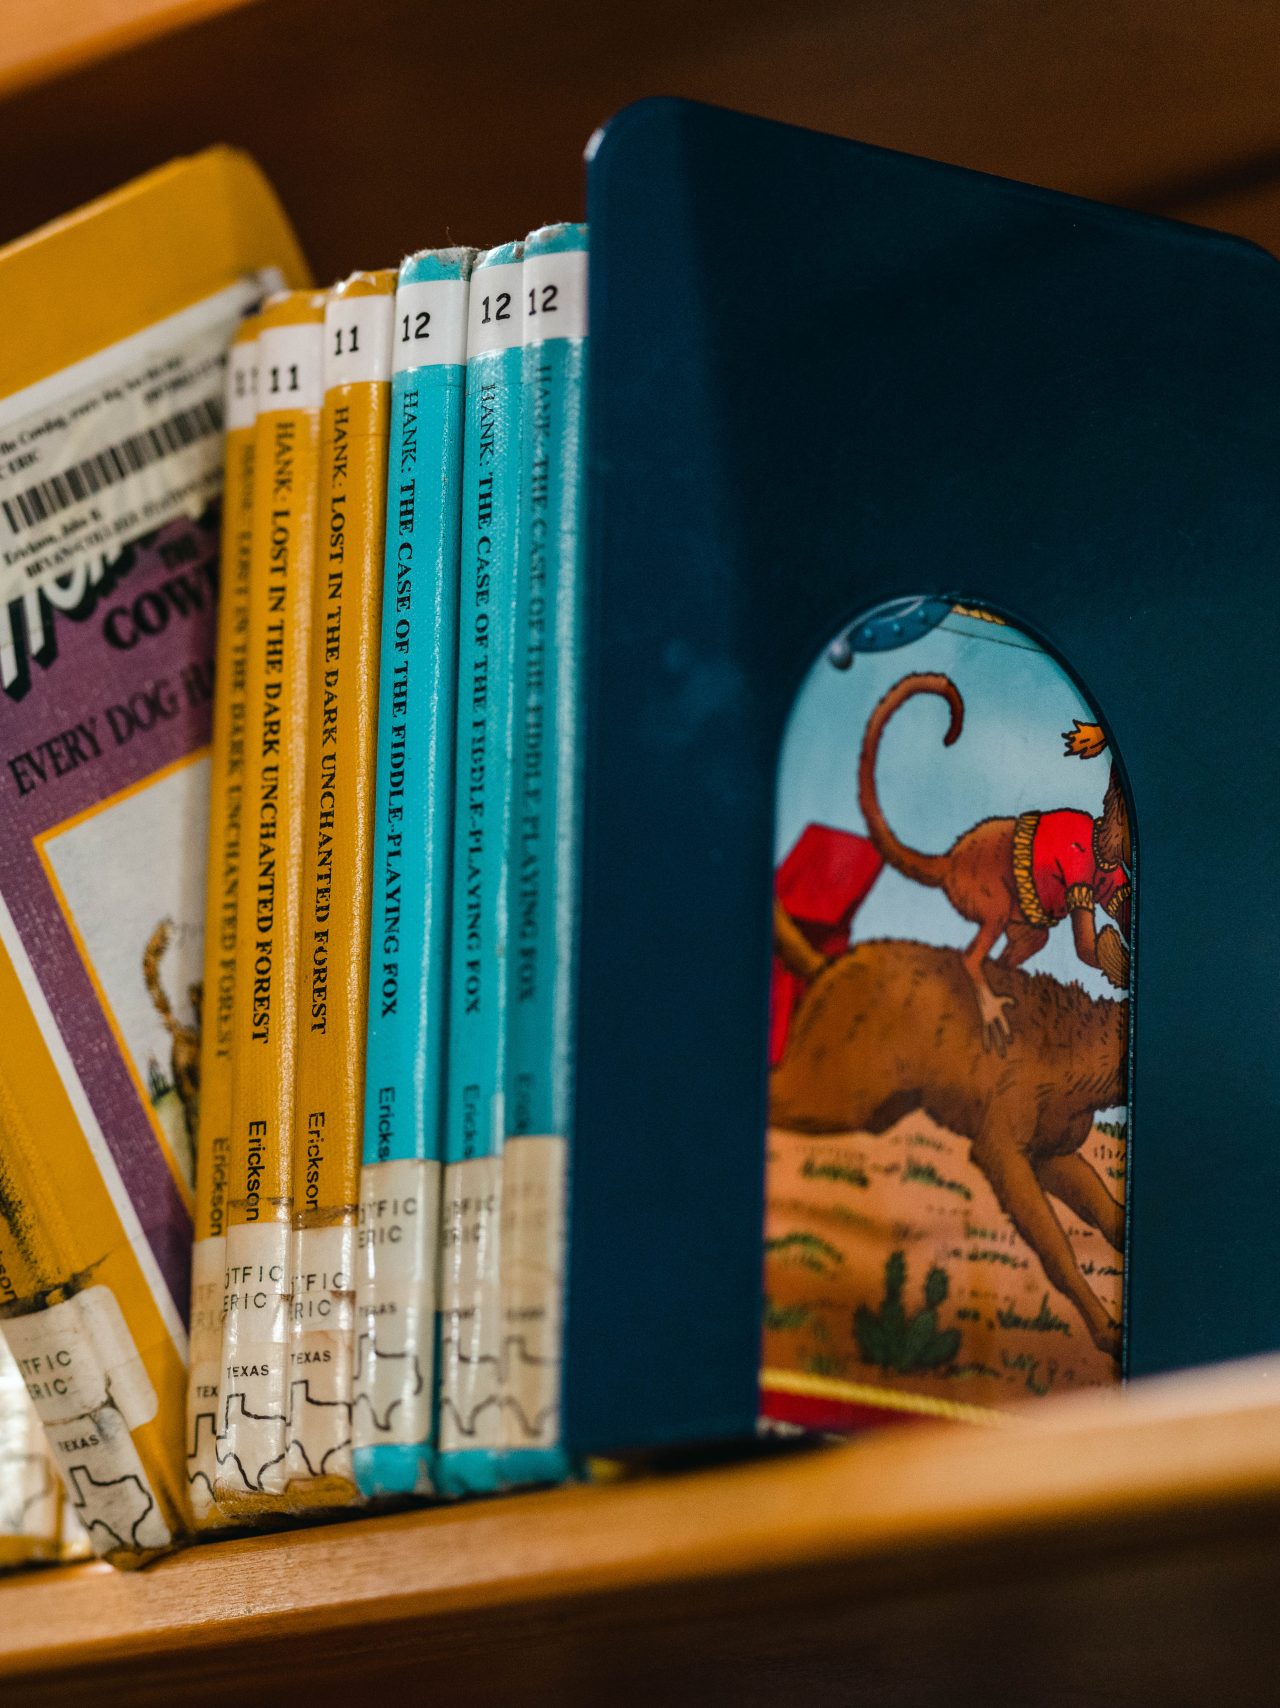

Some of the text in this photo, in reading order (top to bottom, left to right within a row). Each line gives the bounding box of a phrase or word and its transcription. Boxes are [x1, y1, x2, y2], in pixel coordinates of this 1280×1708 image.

[402, 311, 431, 342] 12
[482, 292, 511, 324] 12
[529, 284, 558, 316] 12
[334, 325, 360, 355] 11
[269, 365, 300, 393] 11
[103, 560, 216, 650] COW
[311, 405, 350, 1035] HANK: LOST IN THE DARK UNCHANTED FOREST
[381, 389, 419, 1019] HANK: THE CASE OF THE FIDDLE-PLAYING FOX
[463, 383, 496, 1015] HANK: THE CASE OF THE FIDDLE-PLAYING FOX
[7, 715, 103, 798] EVERY
[106, 678, 181, 747] DOG
[252, 421, 296, 1045] HANK: LOST IN THE DARK UNCHANTED FOREST
[517, 950, 538, 1004] FOX
[378, 1086, 396, 1163] Ericks
[462, 1083, 481, 1159] Ericks
[210, 1136, 231, 1237] Erickson
[246, 1120, 267, 1222] Erickson
[306, 1111, 326, 1214] Erickson
[223, 1292, 267, 1312] ERIC
[227, 1364, 270, 1379] TEXAS
[291, 1350, 332, 1365] TEXAS
[197, 1385, 219, 1398] TEX
[58, 1435, 100, 1453] TEXAS
